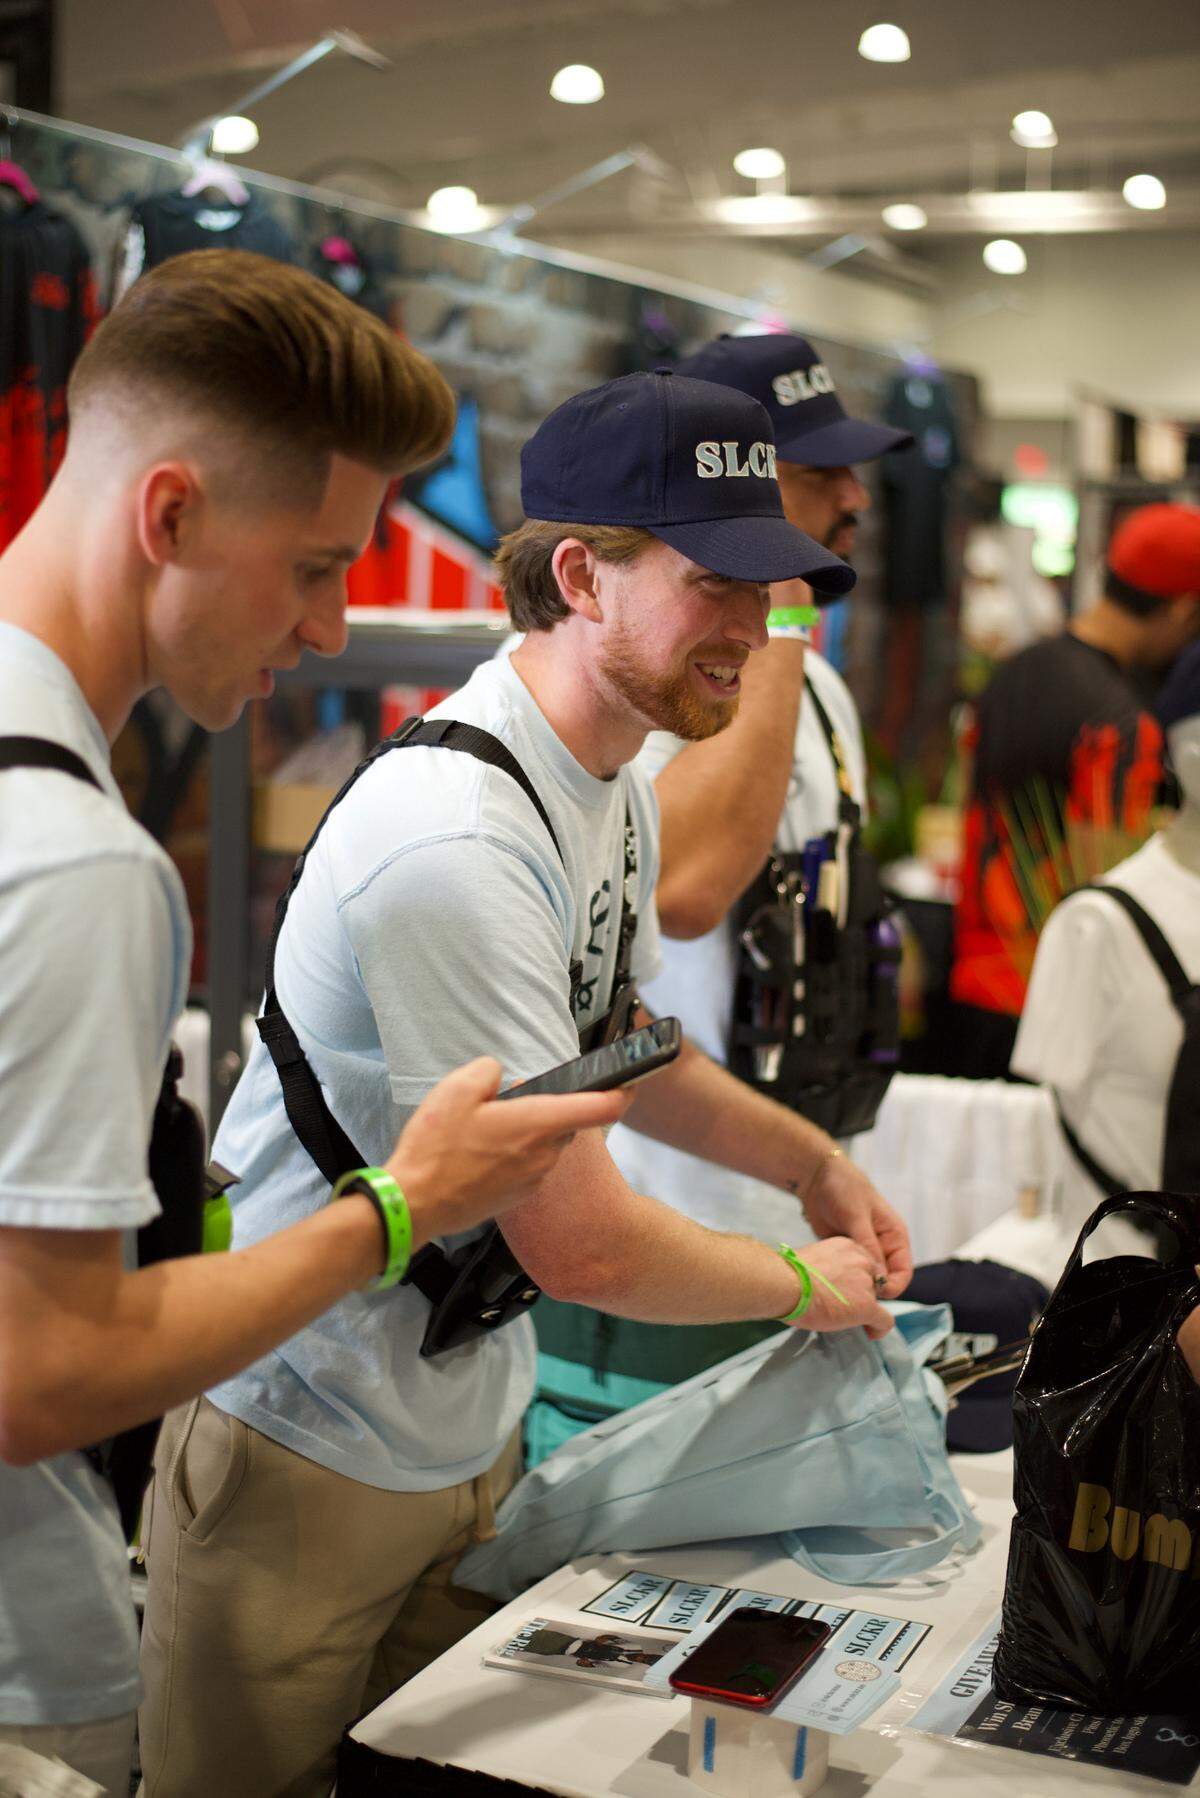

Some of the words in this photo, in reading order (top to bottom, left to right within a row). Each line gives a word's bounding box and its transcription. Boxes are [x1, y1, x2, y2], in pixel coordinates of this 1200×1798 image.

[1068, 1482, 1193, 1571] Bum
[609, 1579, 664, 1614] SLCKR
[669, 1588, 711, 1625] SLCKR
[844, 1618, 890, 1656] SLCKR
[978, 1708, 1009, 1731] Win
[1011, 1707, 1044, 1731] Bran
